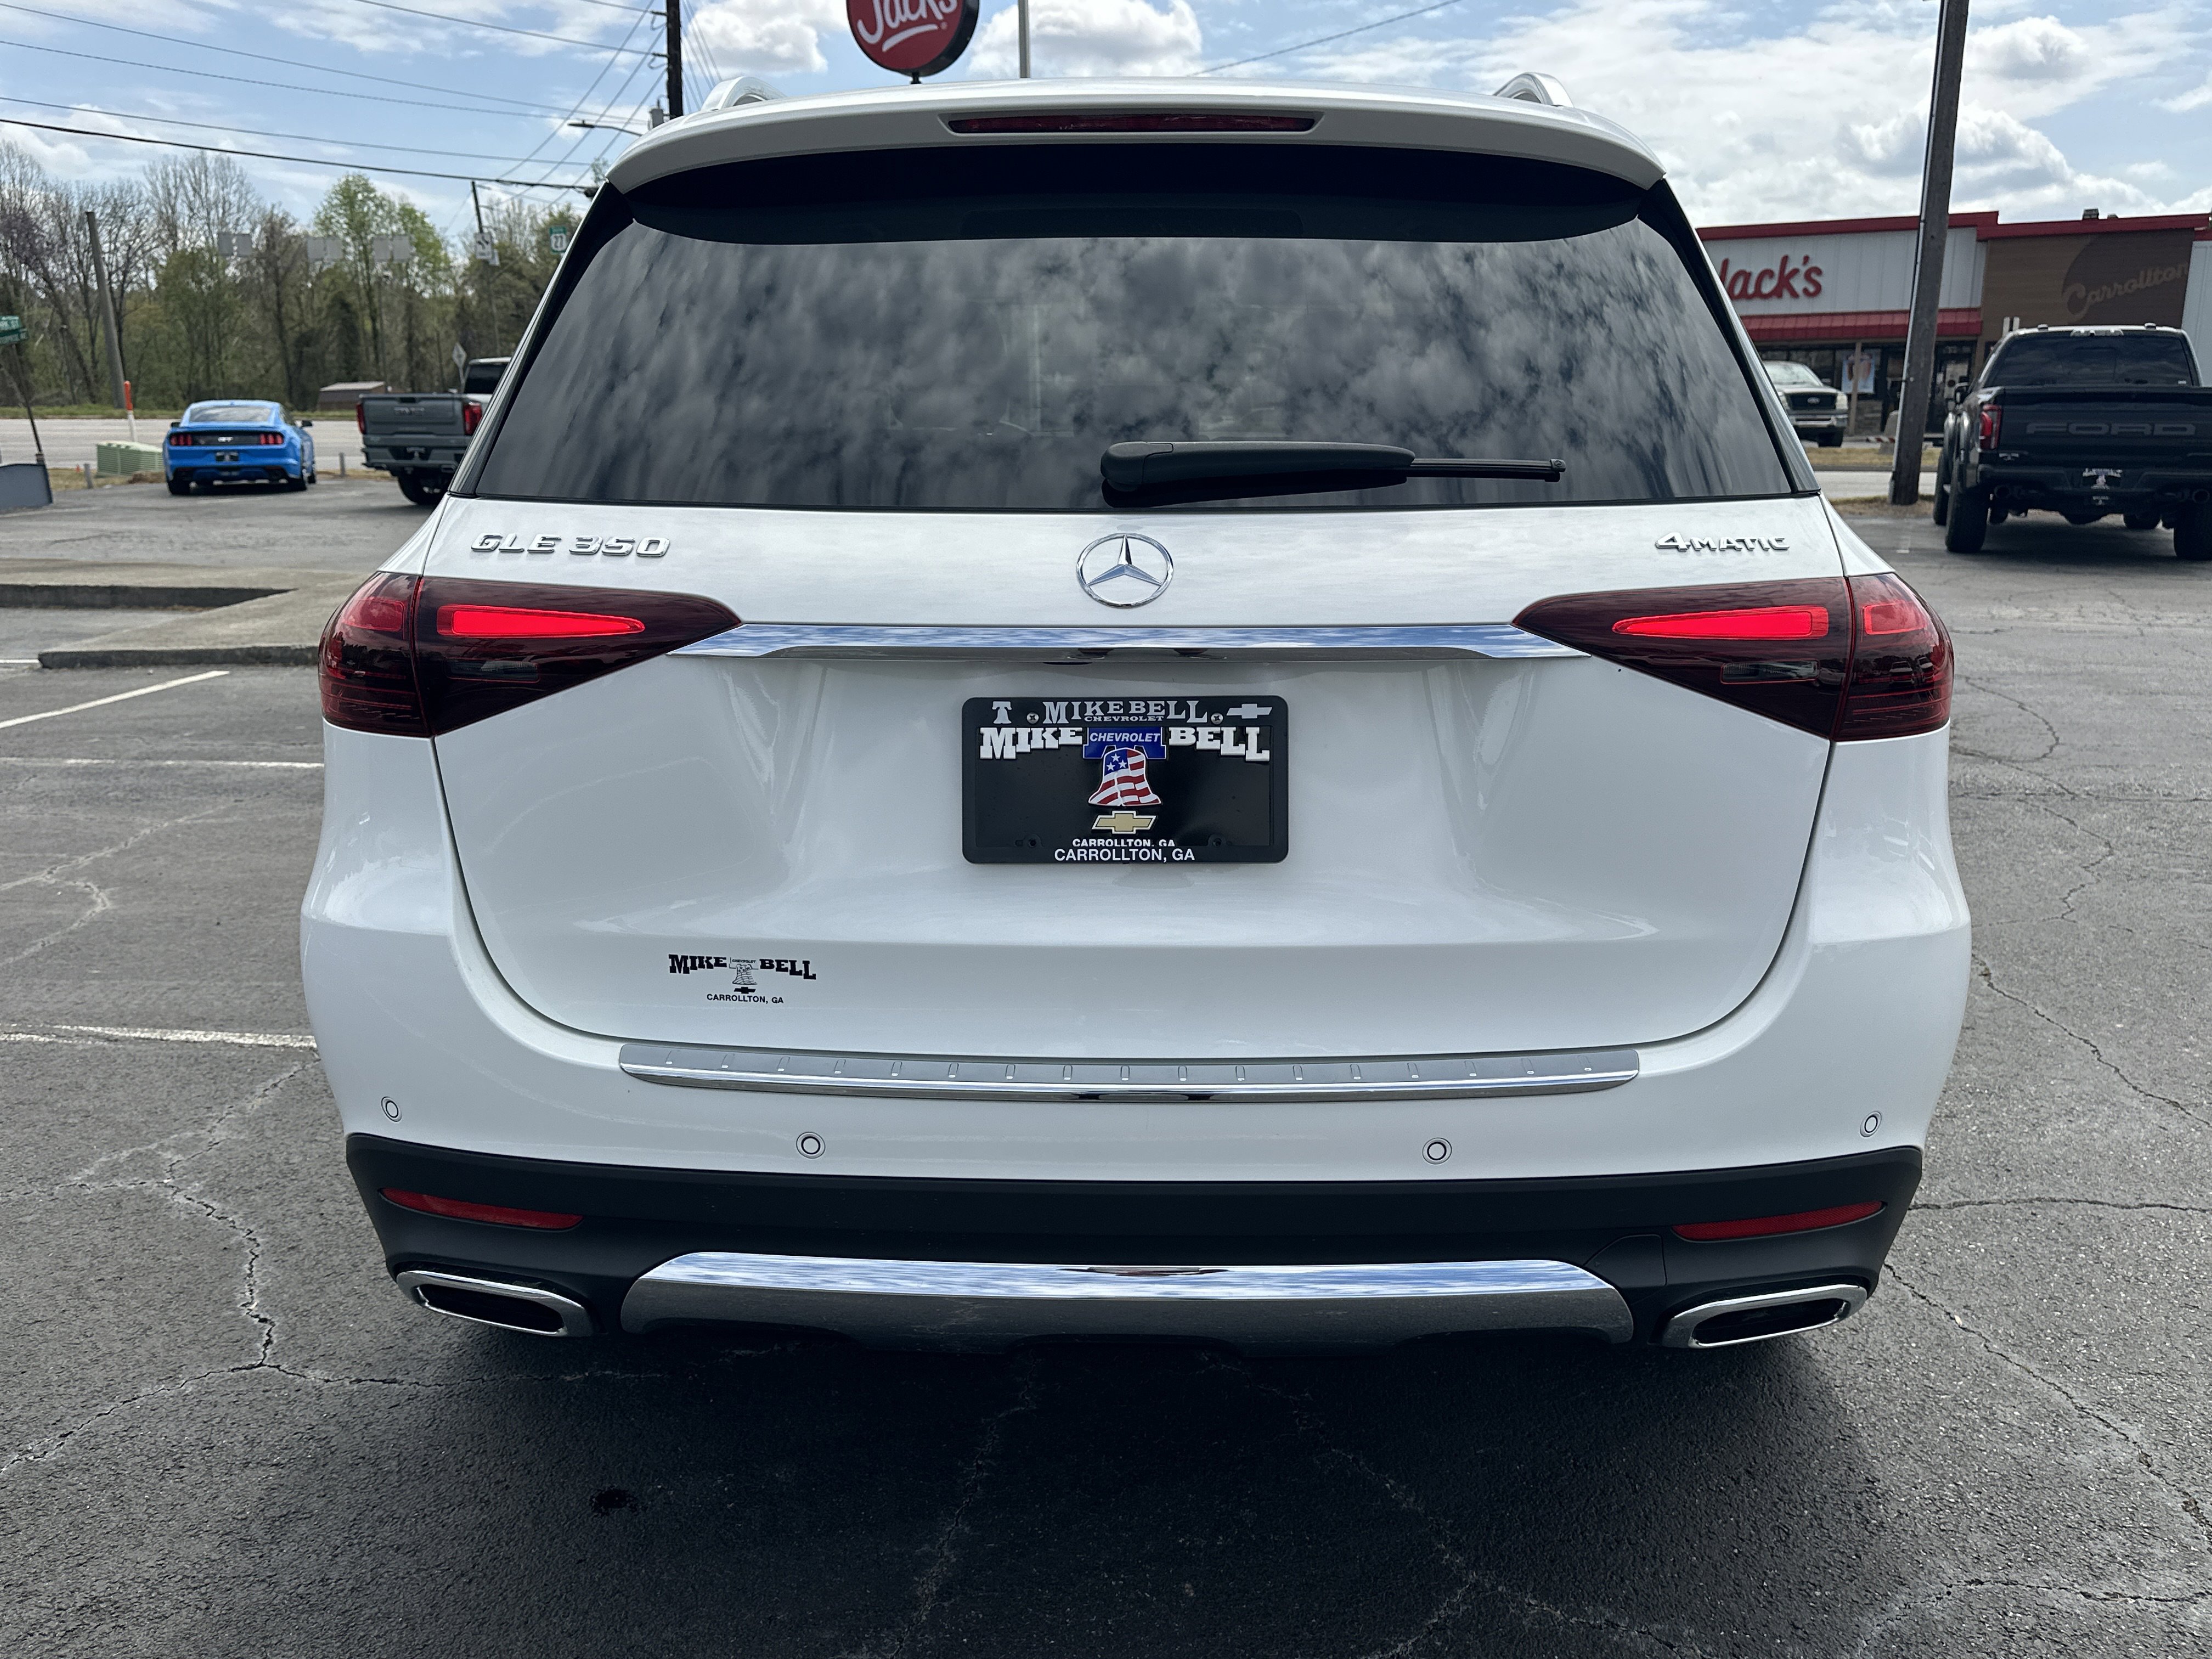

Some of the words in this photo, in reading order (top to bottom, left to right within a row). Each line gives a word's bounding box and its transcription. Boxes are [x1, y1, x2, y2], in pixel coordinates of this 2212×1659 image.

[2026, 422, 2196, 435] FORD
[471, 532, 562, 553] GLE
[568, 535, 671, 557] 350
[1655, 532, 1790, 552] 4MATIC
[1042, 701, 1124, 724] MIKE
[1128, 700, 1207, 723] BELL
[980, 727, 1083, 760] MIKE
[1169, 726, 1269, 761] BELL
[1090, 732, 1161, 742] CHEVROLET
[1054, 848, 1167, 863] CARROLLTON,
[1172, 848, 1195, 861] GA
[668, 953, 727, 974] MIKE
[759, 958, 816, 980] BELL
[707, 993, 768, 1004] CARROLLTON,
